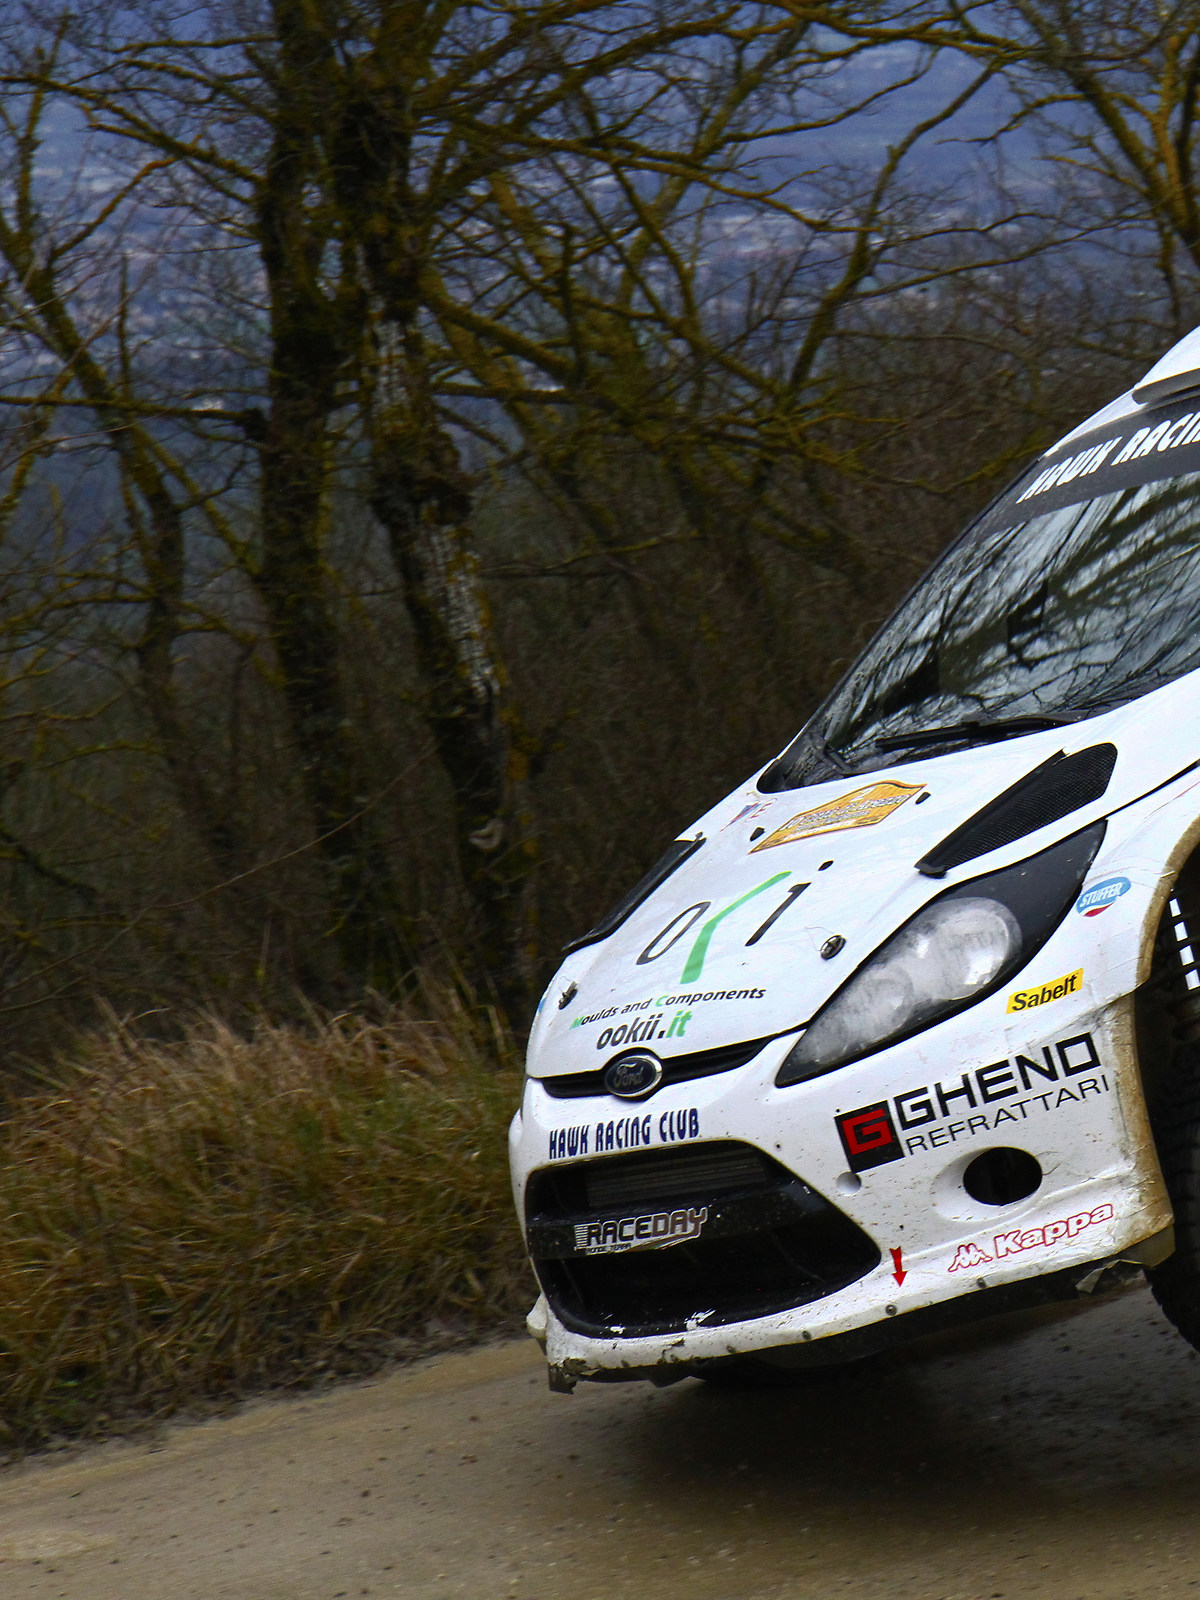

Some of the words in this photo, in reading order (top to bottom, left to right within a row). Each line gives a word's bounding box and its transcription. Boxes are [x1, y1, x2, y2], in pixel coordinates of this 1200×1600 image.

[1016, 436, 1123, 504] HAWK
[1079, 882, 1123, 908] STUFFER
[569, 1006, 617, 1030] Moulds
[620, 997, 653, 1015] and
[655, 987, 767, 1007] Components
[1012, 973, 1079, 1012] Sabelt
[597, 1009, 693, 1050] ookii.it
[613, 1063, 645, 1088] Ford
[893, 1032, 1101, 1130] GHENO
[549, 1125, 590, 1160] HAWK
[595, 1114, 652, 1153] RACING
[659, 1107, 700, 1142] CLUB
[905, 1074, 1110, 1156] REFRATTARI
[584, 1206, 708, 1248] RACEDAY
[994, 1203, 1114, 1258] Kappa
